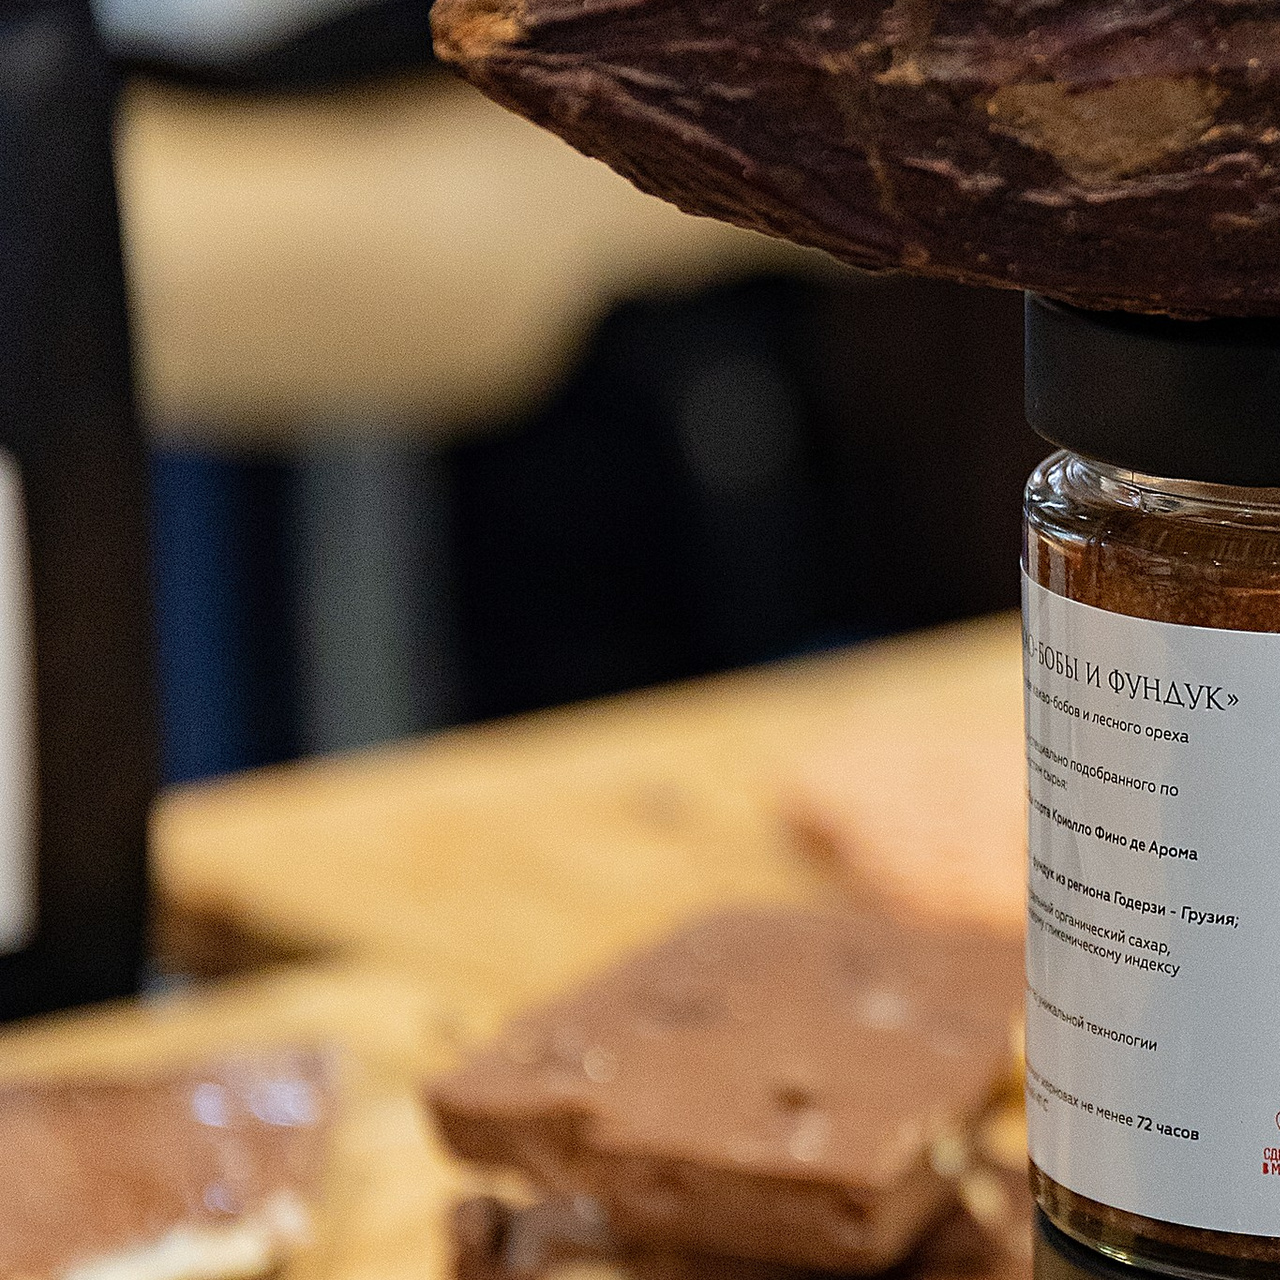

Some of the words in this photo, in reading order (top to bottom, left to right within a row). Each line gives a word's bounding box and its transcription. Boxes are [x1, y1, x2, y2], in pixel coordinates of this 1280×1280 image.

[1085, 661, 1102, 689] И
[1107, 668, 1240, 712] ФУНДУК»
[1082, 709, 1090, 721] и
[1091, 712, 1142, 735] лесного
[1145, 726, 1190, 744] ореха
[1070, 758, 1156, 794] подобранного
[1160, 783, 1180, 798] по
[1051, 808, 1092, 837] Криолло
[1094, 825, 1128, 847] Фино
[1129, 837, 1146, 852] де
[1148, 840, 1199, 862] Арома
[1055, 871, 1066, 887] из
[1067, 876, 1112, 903] региона
[1113, 890, 1167, 917] Годерзи
[1180, 905, 1240, 929] Грузия;
[1054, 909, 1126, 944] органический
[1128, 935, 1172, 958] сахар,
[1124, 949, 1181, 978] индексу
[1086, 1020, 1158, 1052] технологии
[1080, 1099, 1095, 1114] не
[1096, 1105, 1134, 1128] менее
[1136, 1114, 1153, 1132] 72
[1156, 1122, 1200, 1142] часов
